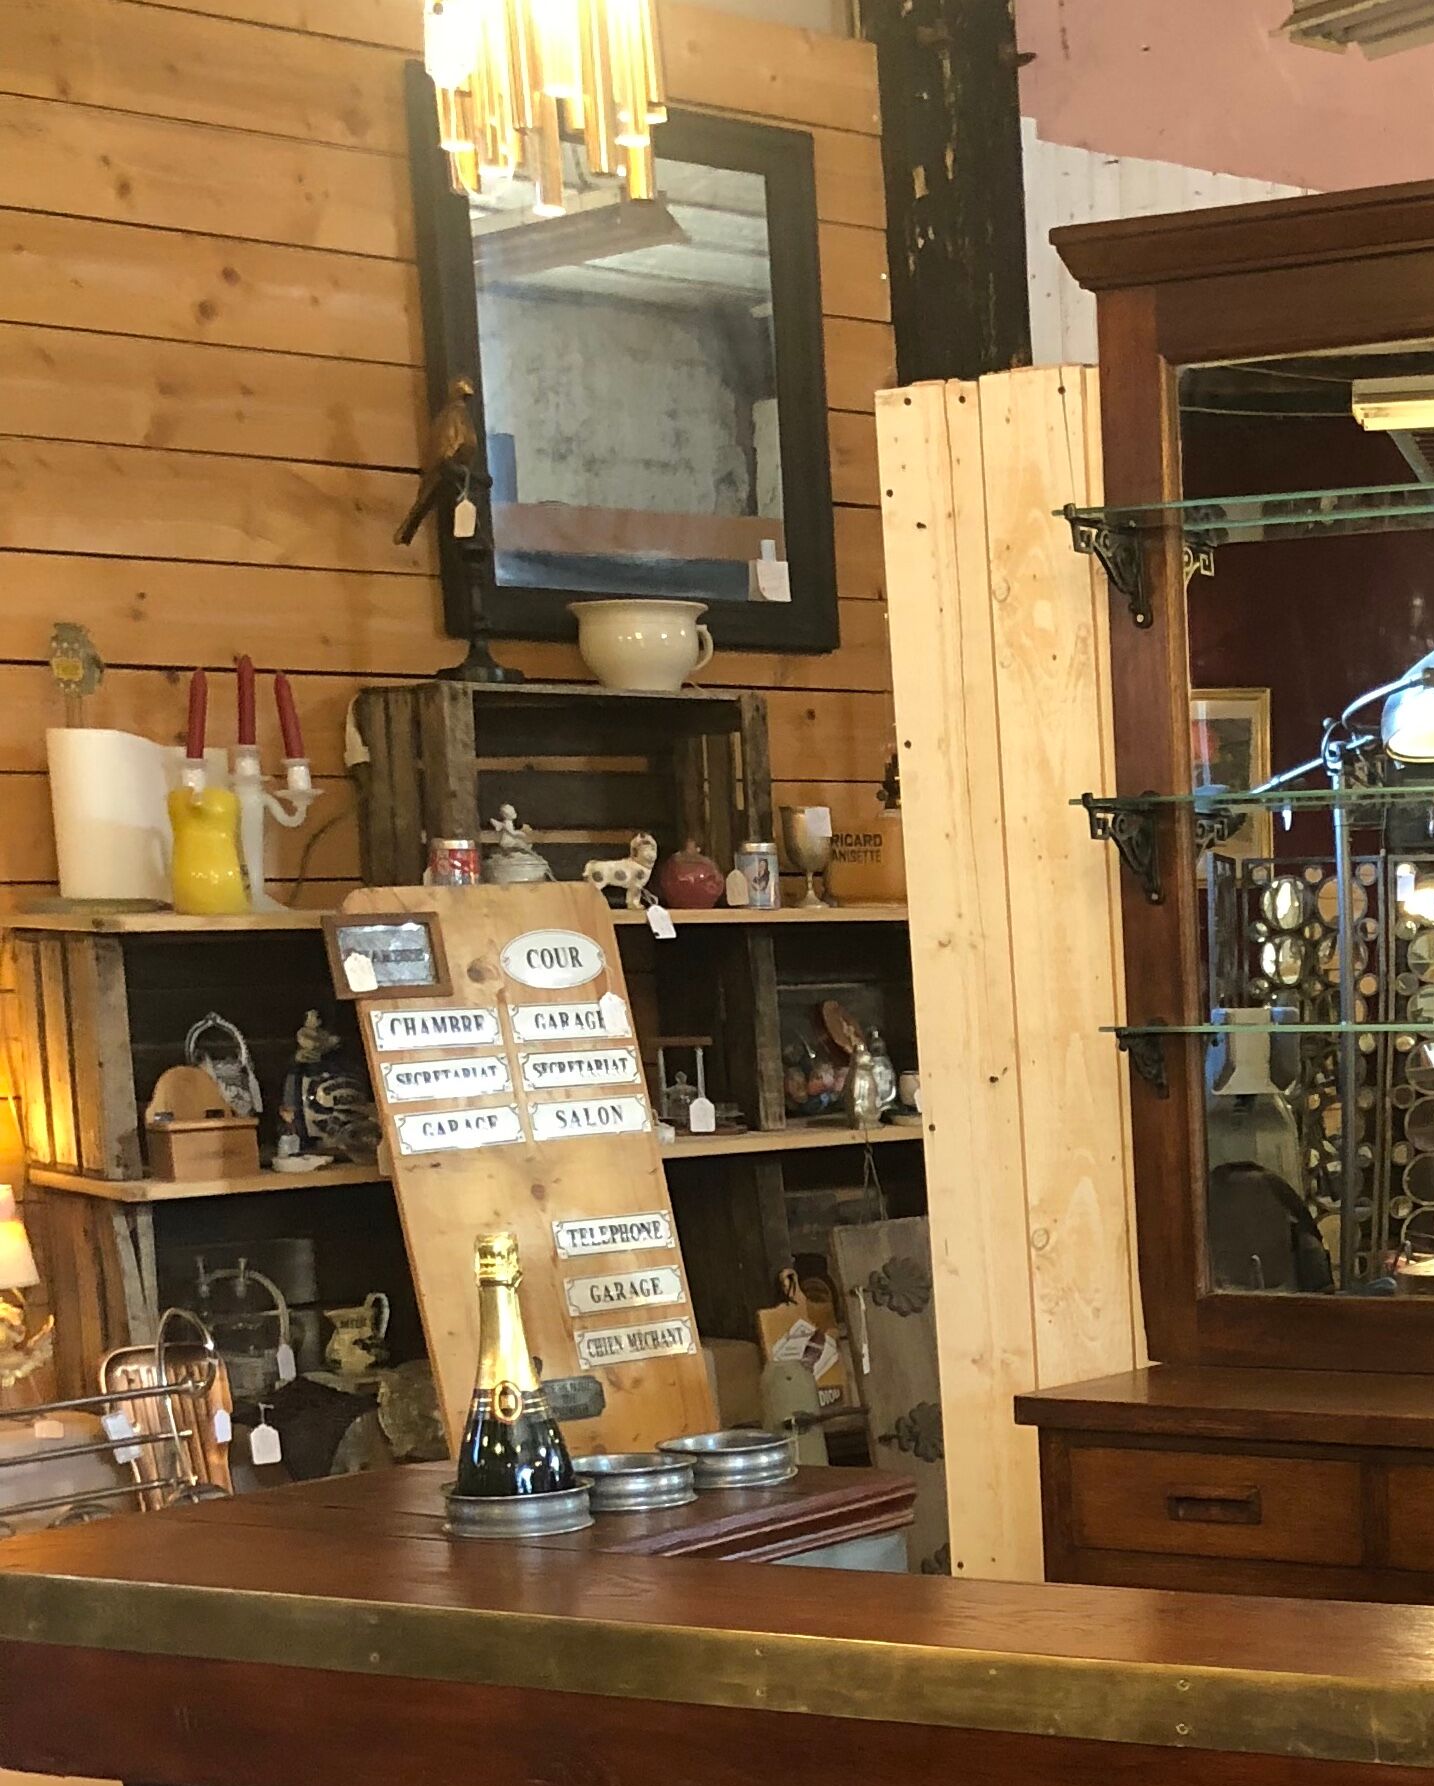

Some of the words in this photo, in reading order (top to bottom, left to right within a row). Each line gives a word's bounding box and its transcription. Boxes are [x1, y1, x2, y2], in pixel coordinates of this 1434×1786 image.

[526, 946, 583, 970] COUR
[389, 1014, 485, 1037] CHAMBRE
[395, 1065, 497, 1086] SECRETARIAT
[532, 1056, 628, 1078] SECRETARIAT
[422, 1114, 498, 1137] GARAGE
[555, 1104, 624, 1129] SALON
[566, 1219, 663, 1249] TELEPHONE
[589, 1276, 664, 1305] GARAGE
[586, 1335, 624, 1359] CHIEN
